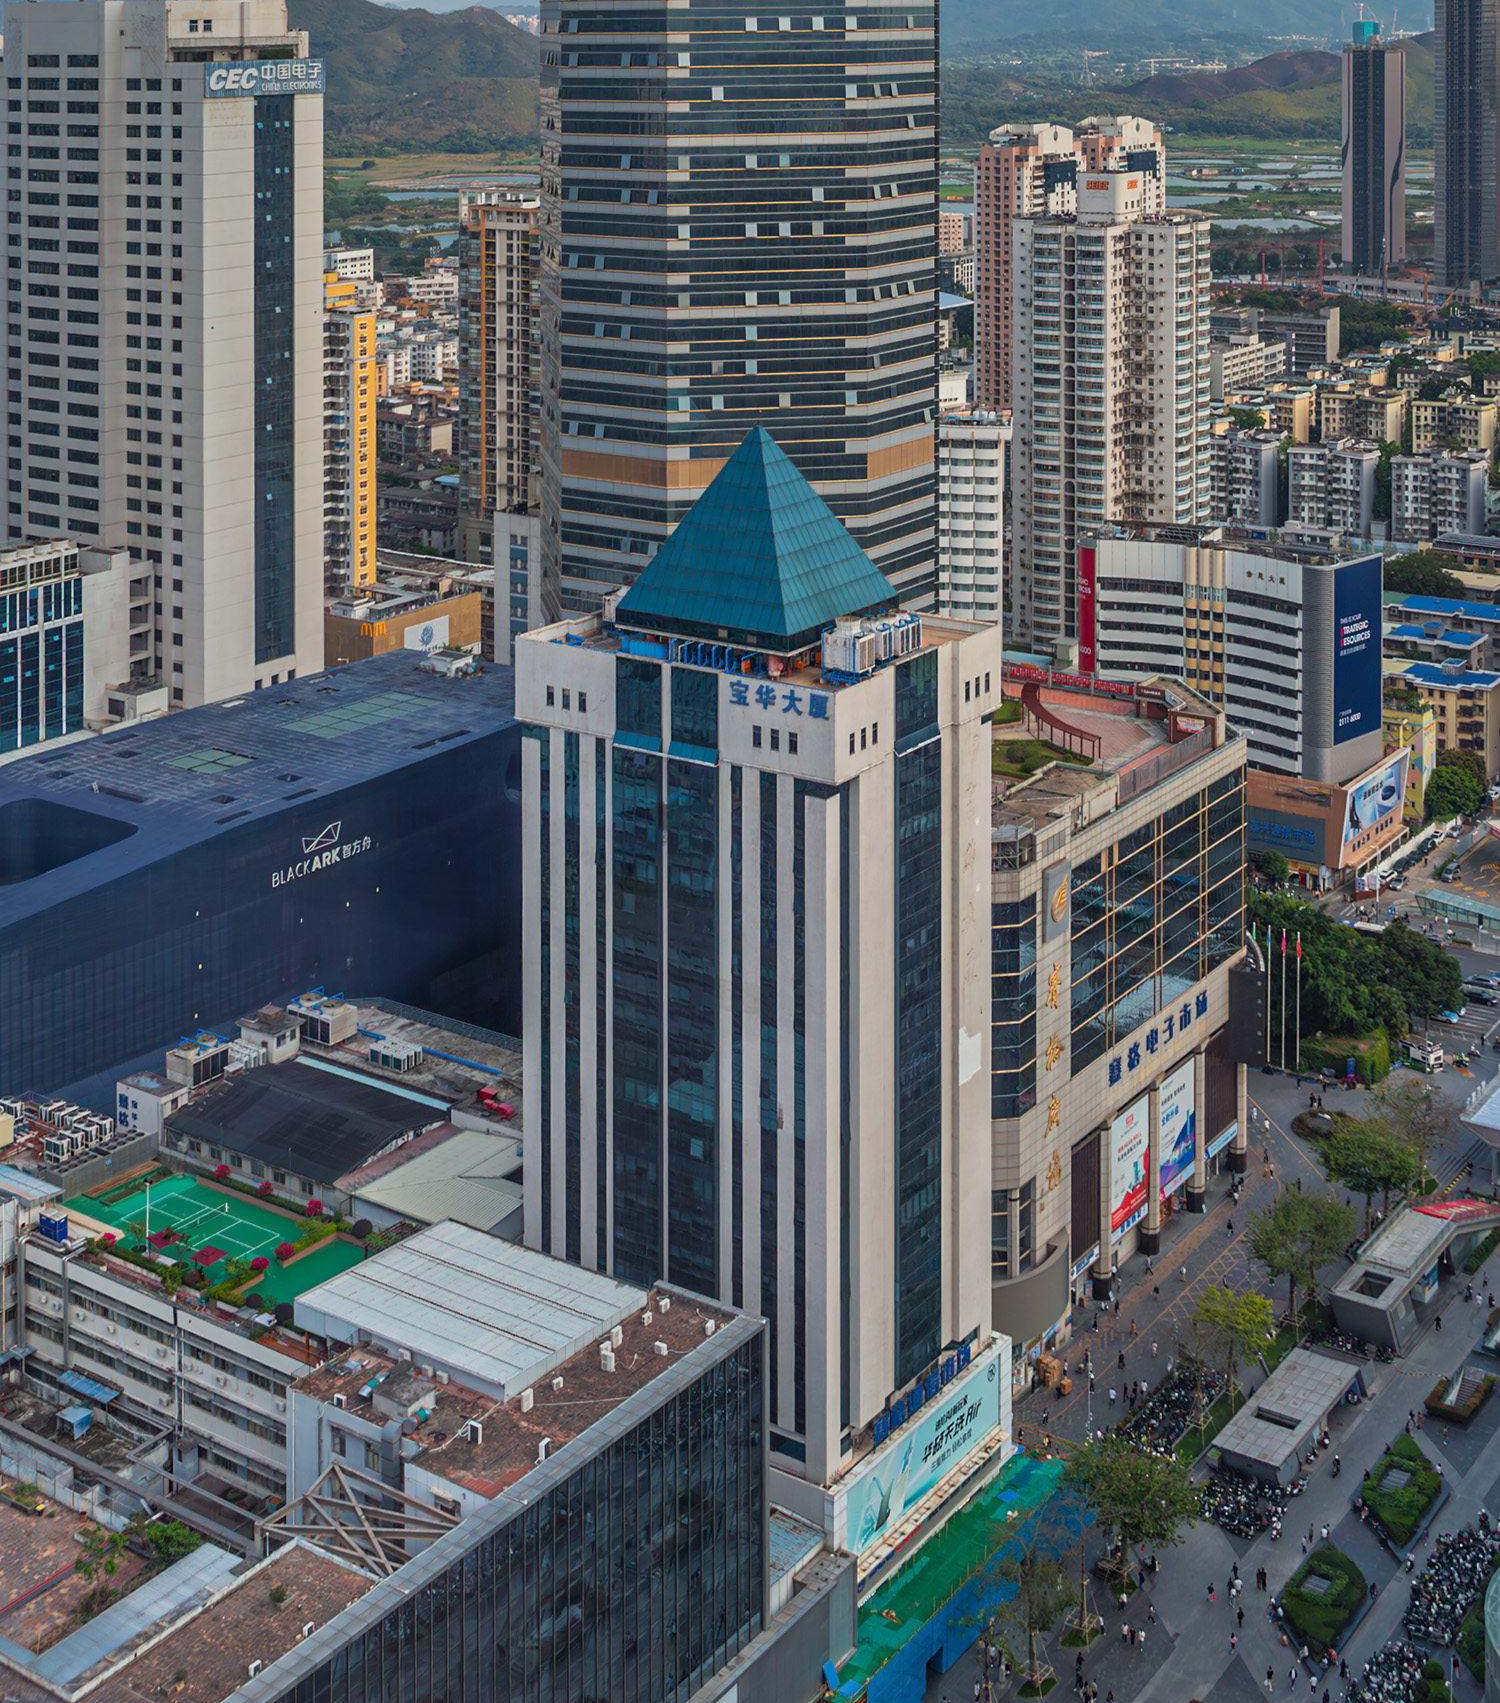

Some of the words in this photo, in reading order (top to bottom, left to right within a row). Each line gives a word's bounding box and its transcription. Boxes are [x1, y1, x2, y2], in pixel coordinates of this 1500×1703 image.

[209, 67, 259, 91] CEC
[261, 62, 322, 81] 中国电子
[262, 81, 281, 92] CHINA
[283, 79, 322, 91] ELECTRONICS
[1340, 619, 1369, 637] STRATEGIC
[1340, 630, 1371, 647] RESOURCES
[729, 680, 830, 721] 宝华大厦
[342, 836, 372, 859] 智方舟
